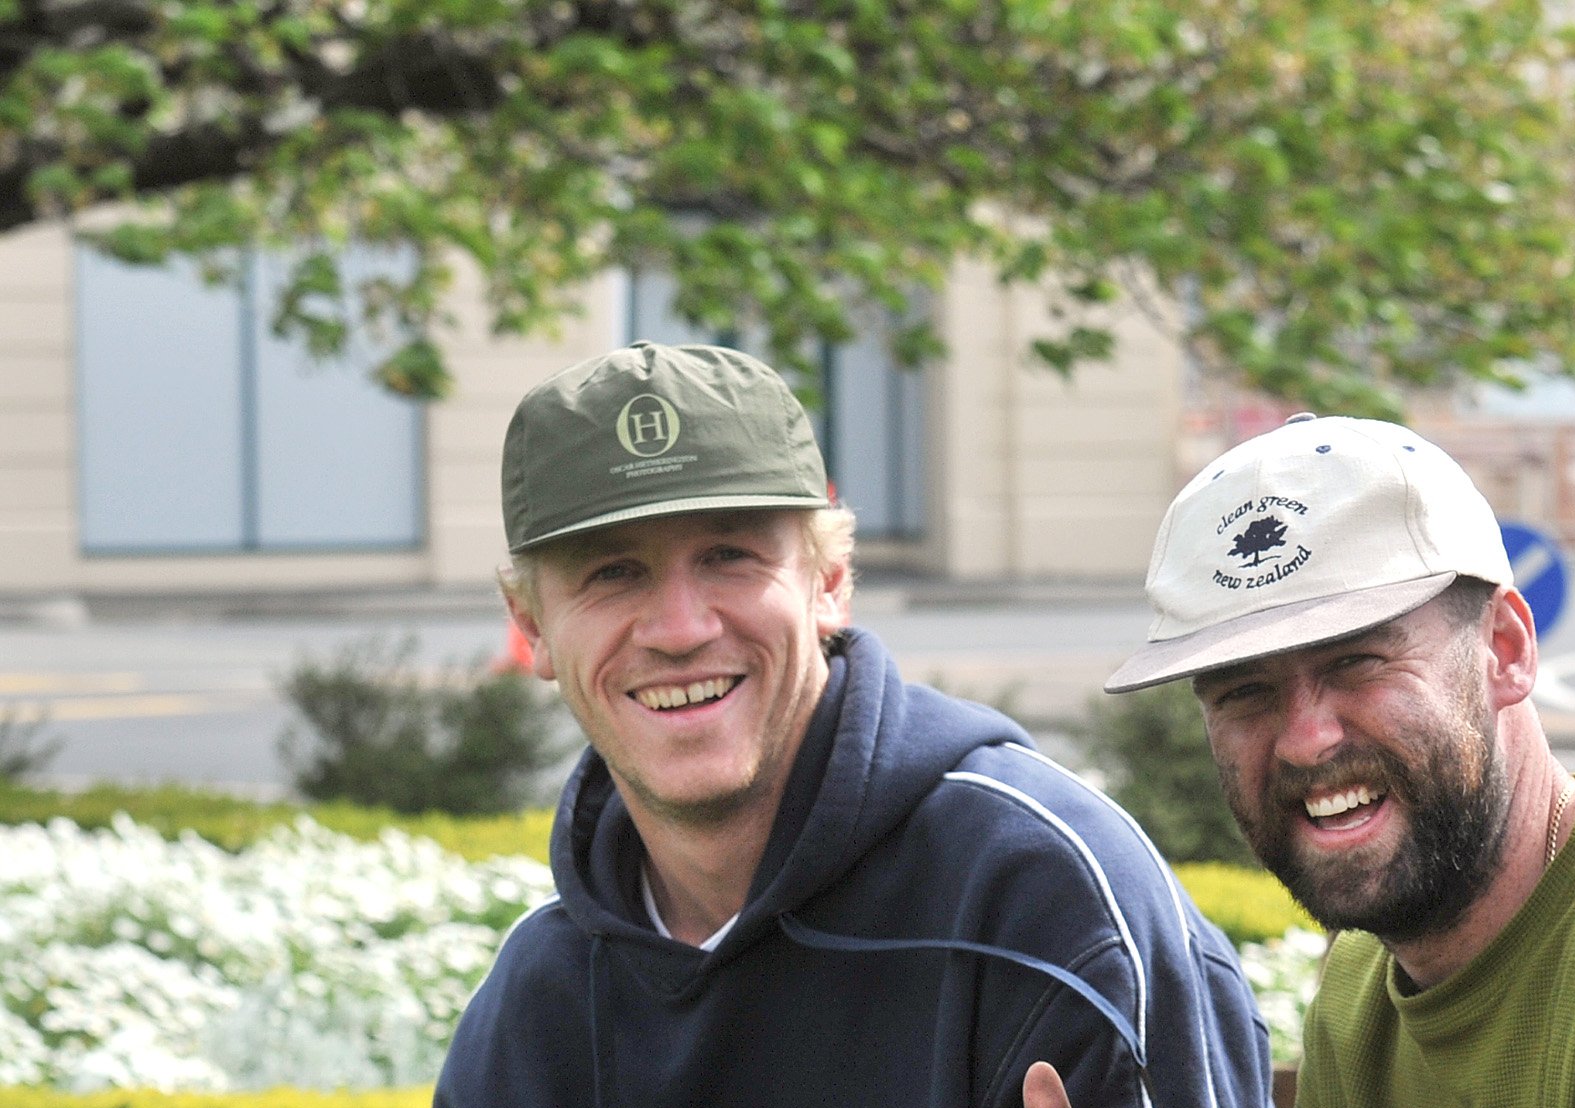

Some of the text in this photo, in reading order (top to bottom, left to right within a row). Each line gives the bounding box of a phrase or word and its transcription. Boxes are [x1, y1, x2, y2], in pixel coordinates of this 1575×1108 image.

[1216, 495, 1309, 535] clean green
[1212, 544, 1312, 590] new zealand
